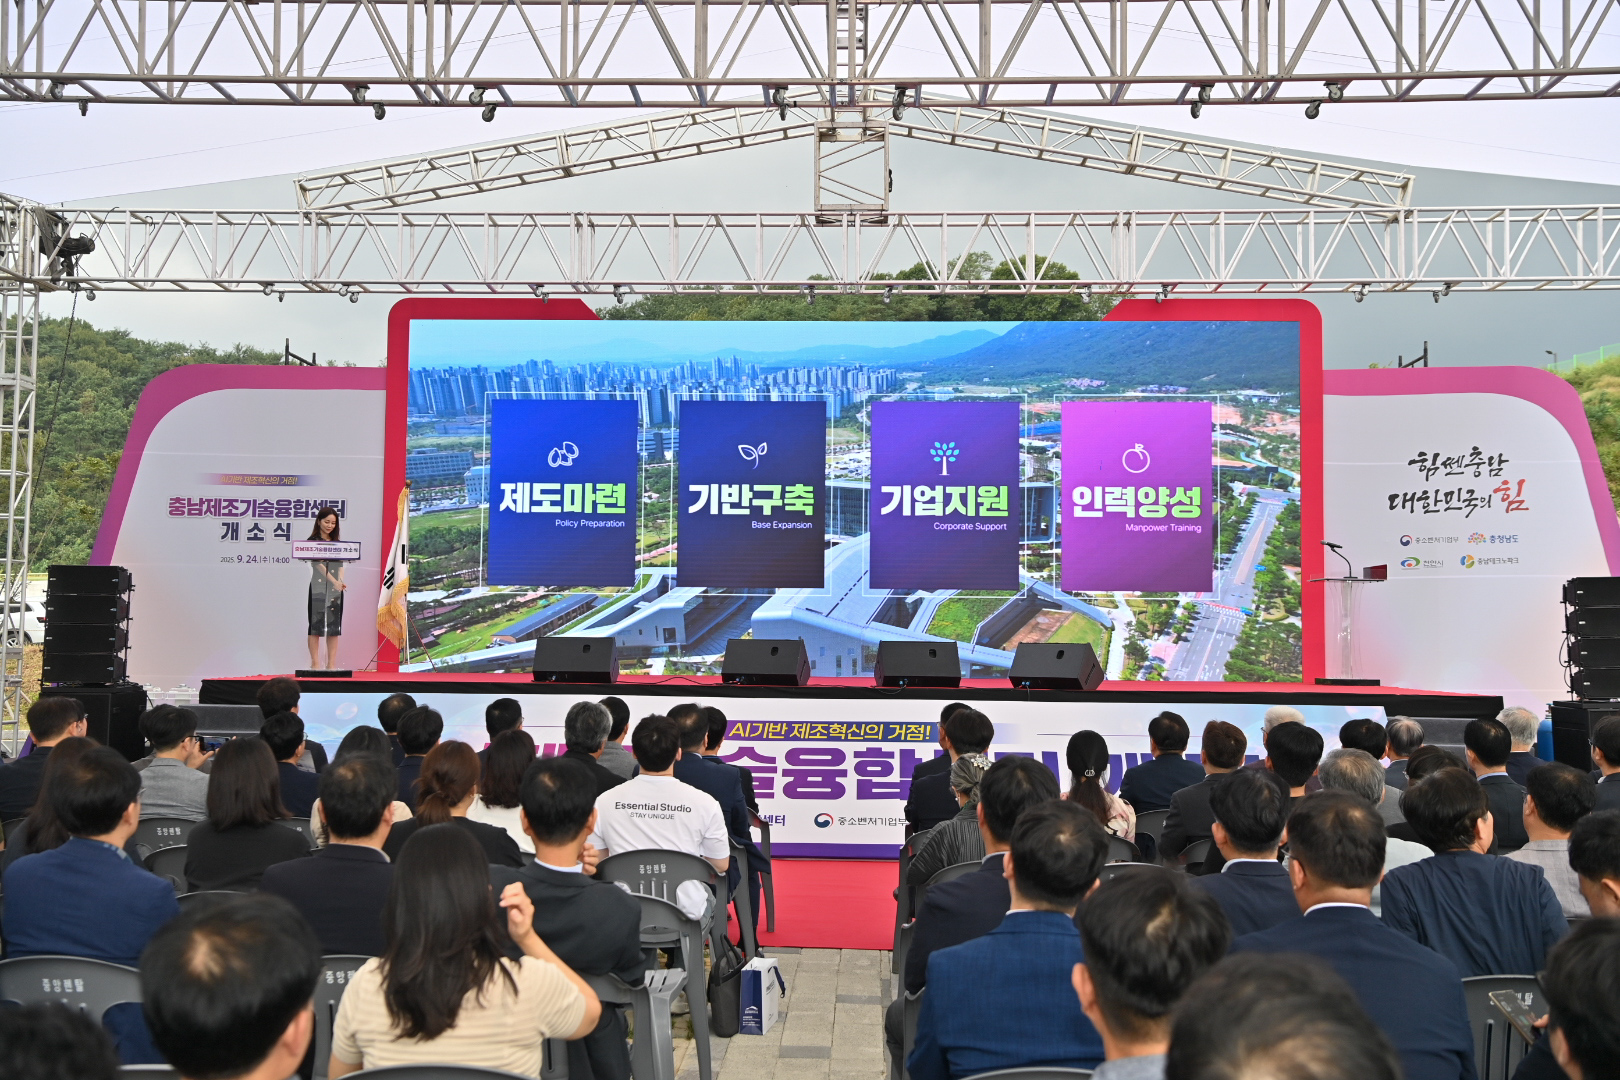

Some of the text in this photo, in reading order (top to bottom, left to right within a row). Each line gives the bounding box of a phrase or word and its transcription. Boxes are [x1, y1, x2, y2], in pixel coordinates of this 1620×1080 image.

[499, 482, 626, 514] 제도마련
[688, 483, 815, 516] 기반구축
[880, 485, 1009, 517] 기업지원
[1072, 486, 1202, 518] 인력양성
[1387, 478, 1530, 518] 대한민국의 힘
[555, 519, 625, 529] Policy Preparation
[752, 521, 812, 530] Base Expansion
[934, 522, 1007, 532] Corporate Support
[1126, 523, 1202, 533] Manpower Training
[1489, 534, 1519, 543] 충청남도
[272, 556, 290, 564] 14:00
[729, 722, 931, 741] AI기반 제조혁신의 거점!
[615, 801, 692, 814] Essential Studio
[629, 811, 675, 820] STAY UNIQUE
[838, 816, 909, 827] 중소벤처기업부
